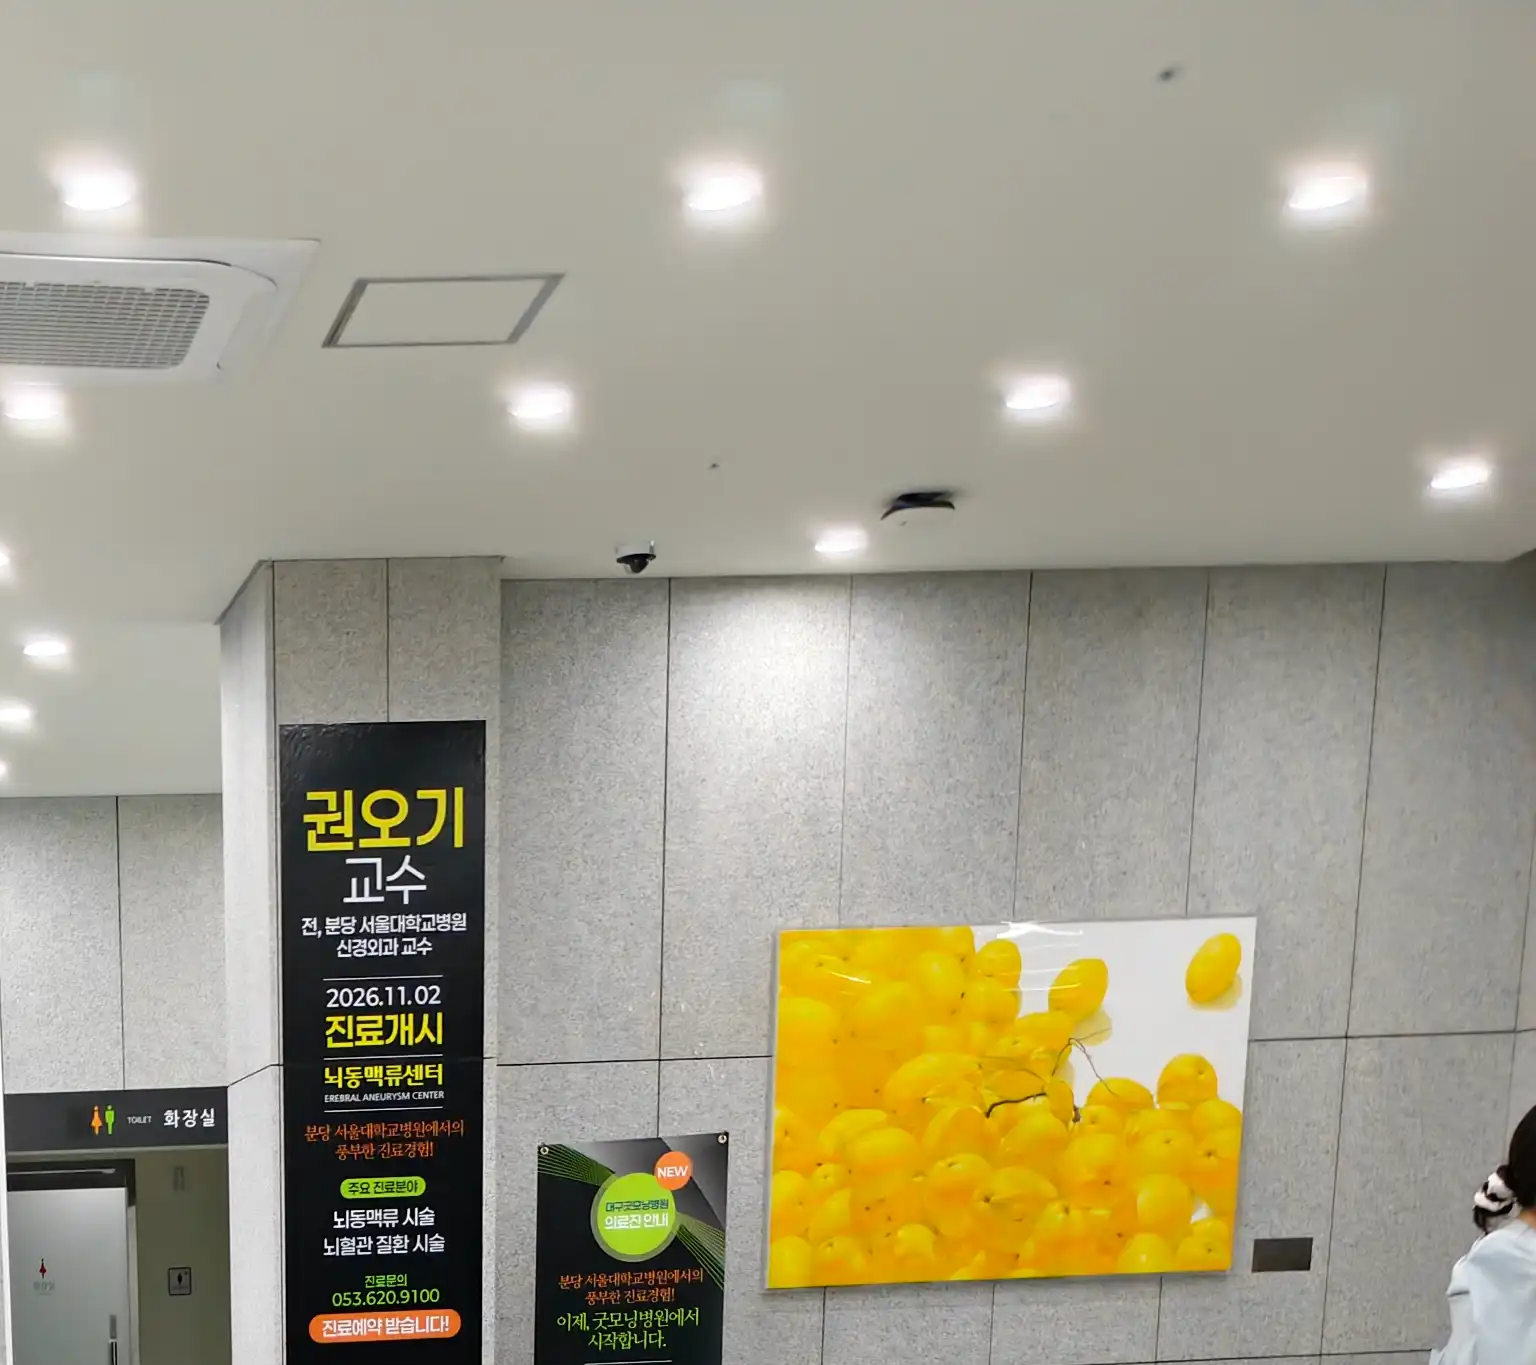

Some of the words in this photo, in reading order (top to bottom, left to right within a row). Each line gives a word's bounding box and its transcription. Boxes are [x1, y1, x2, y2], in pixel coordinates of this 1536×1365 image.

[304, 787, 463, 851] 권오기
[343, 855, 427, 904] 교수
[302, 918, 322, 938] 전,
[325, 917, 357, 936] 분당
[359, 913, 467, 934] 서울대학교병원
[337, 938, 399, 958] 신경외과
[401, 937, 433, 955] 교수
[326, 985, 441, 1008] 2026.11.02
[325, 1012, 443, 1048] 진료개시
[325, 1064, 443, 1088] 뇌동맥류센터
[363, 1092, 410, 1101] ANEURYSM
[412, 1091, 444, 1100] CENTER
[127, 1115, 152, 1124] TOILET
[164, 1108, 216, 1129] 화장실
[304, 1125, 330, 1141] 분당
[335, 1120, 464, 1140] 서울대학교병원에서의
[335, 1143, 375, 1160] 풍부한
[379, 1142, 434, 1158] 진료경험!
[658, 1166, 688, 1178] NEW
[348, 1182, 370, 1195] 주요
[373, 1180, 418, 1194] 진료분야
[333, 1209, 399, 1229] 뇌동맥류
[402, 1207, 435, 1226] 시술
[604, 1214, 641, 1229] 의료진
[644, 1212, 669, 1228] 안내
[323, 1237, 373, 1256] 뇌혈관
[376, 1235, 409, 1255] 질환
[413, 1233, 445, 1252] 시술
[365, 1274, 407, 1288] 진료문의
[559, 1274, 583, 1289] 분당
[332, 1289, 440, 1307] 053.620.9100
[586, 1290, 620, 1305] 풍부한
[624, 1288, 675, 1303] 진료경험!
[322, 1319, 382, 1338] 진료예약
[386, 1316, 449, 1335] 받습니다!
[557, 1313, 589, 1331] 이제,
[592, 1308, 700, 1330] 굿모닝병원에서
[588, 1330, 667, 1350] 시작합니다.
